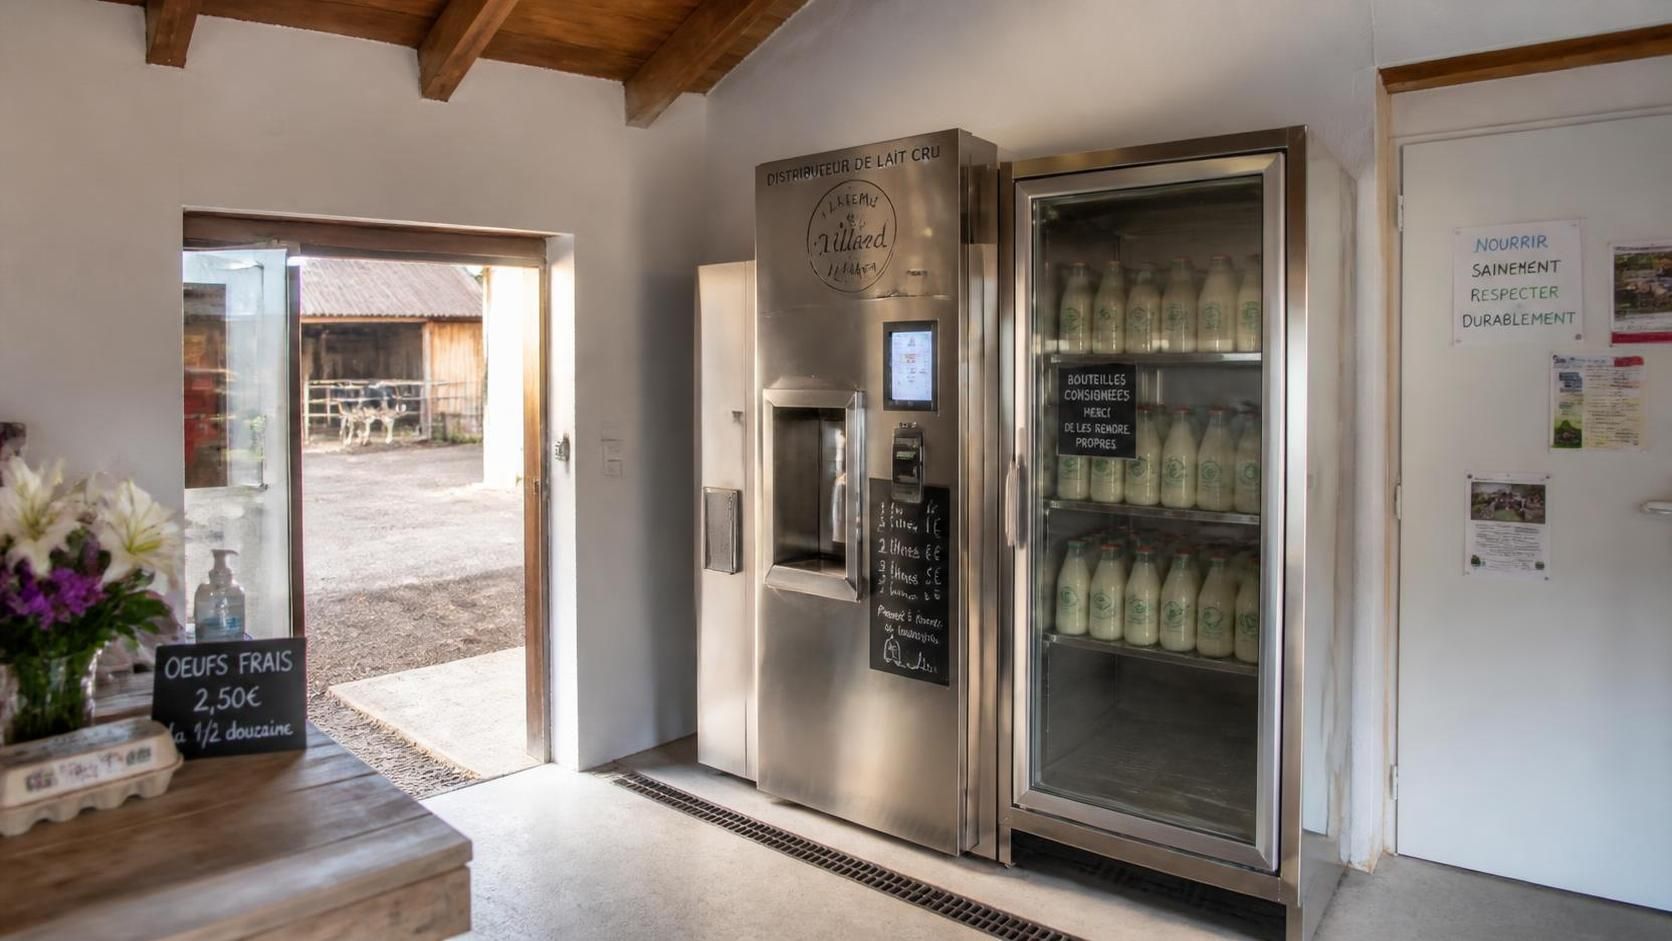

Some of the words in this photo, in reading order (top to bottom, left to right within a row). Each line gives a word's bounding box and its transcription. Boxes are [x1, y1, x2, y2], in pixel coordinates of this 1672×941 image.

[767, 159, 850, 186] DISTRIBUTEUR
[855, 156, 872, 170] DE
[877, 150, 907, 168] LAIT
[911, 145, 941, 162] CRU
[1474, 234, 1549, 253] NOURRIR
[1471, 286, 1560, 302] RESPECTER
[1462, 311, 1576, 328] DURABLEMENT
[1068, 374, 1127, 386] BOUTEILLES
[1064, 423, 1075, 433] DE
[1076, 423, 1092, 433] LES
[1094, 423, 1131, 434] RENDRE
[1076, 437, 1117, 449] PROPRES
[164, 654, 228, 680] OEUFS
[239, 650, 294, 675] FRAIS
[193, 685, 263, 715] 2,50€
[194, 719, 221, 749] 1/2
[226, 720, 293, 741] douzaine
